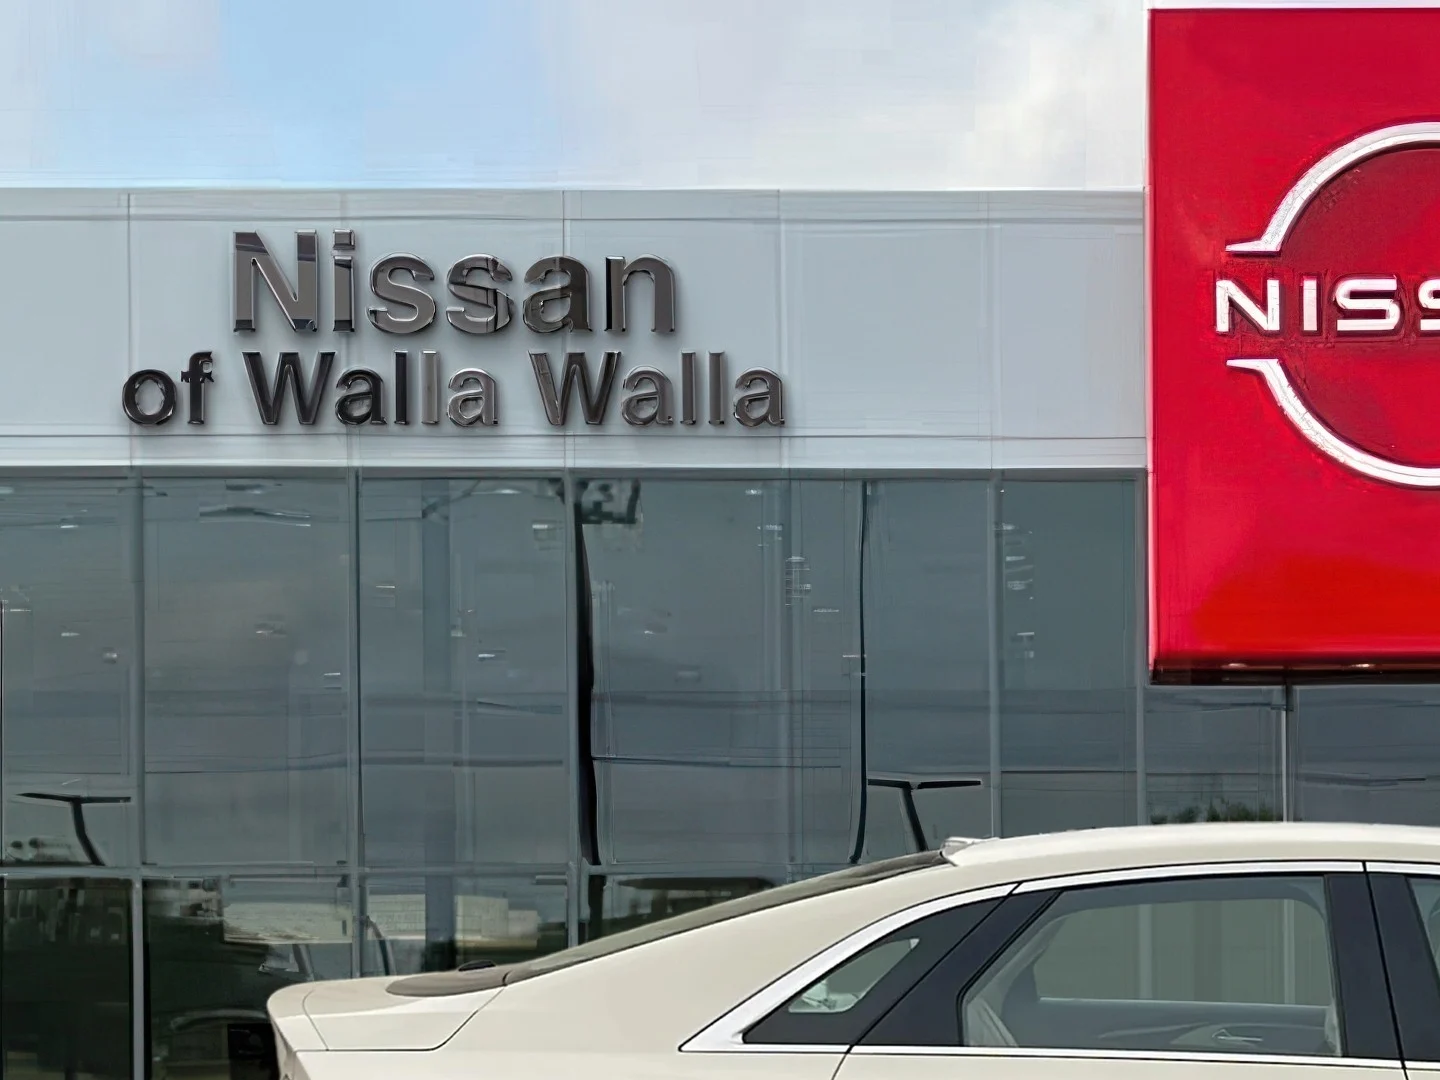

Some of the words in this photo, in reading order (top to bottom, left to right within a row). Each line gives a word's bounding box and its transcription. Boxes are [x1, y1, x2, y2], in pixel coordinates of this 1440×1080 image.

[231, 229, 676, 334] Nissan
[121, 350, 214, 426] of
[241, 350, 499, 427] Walla
[527, 350, 786, 427] Walla
